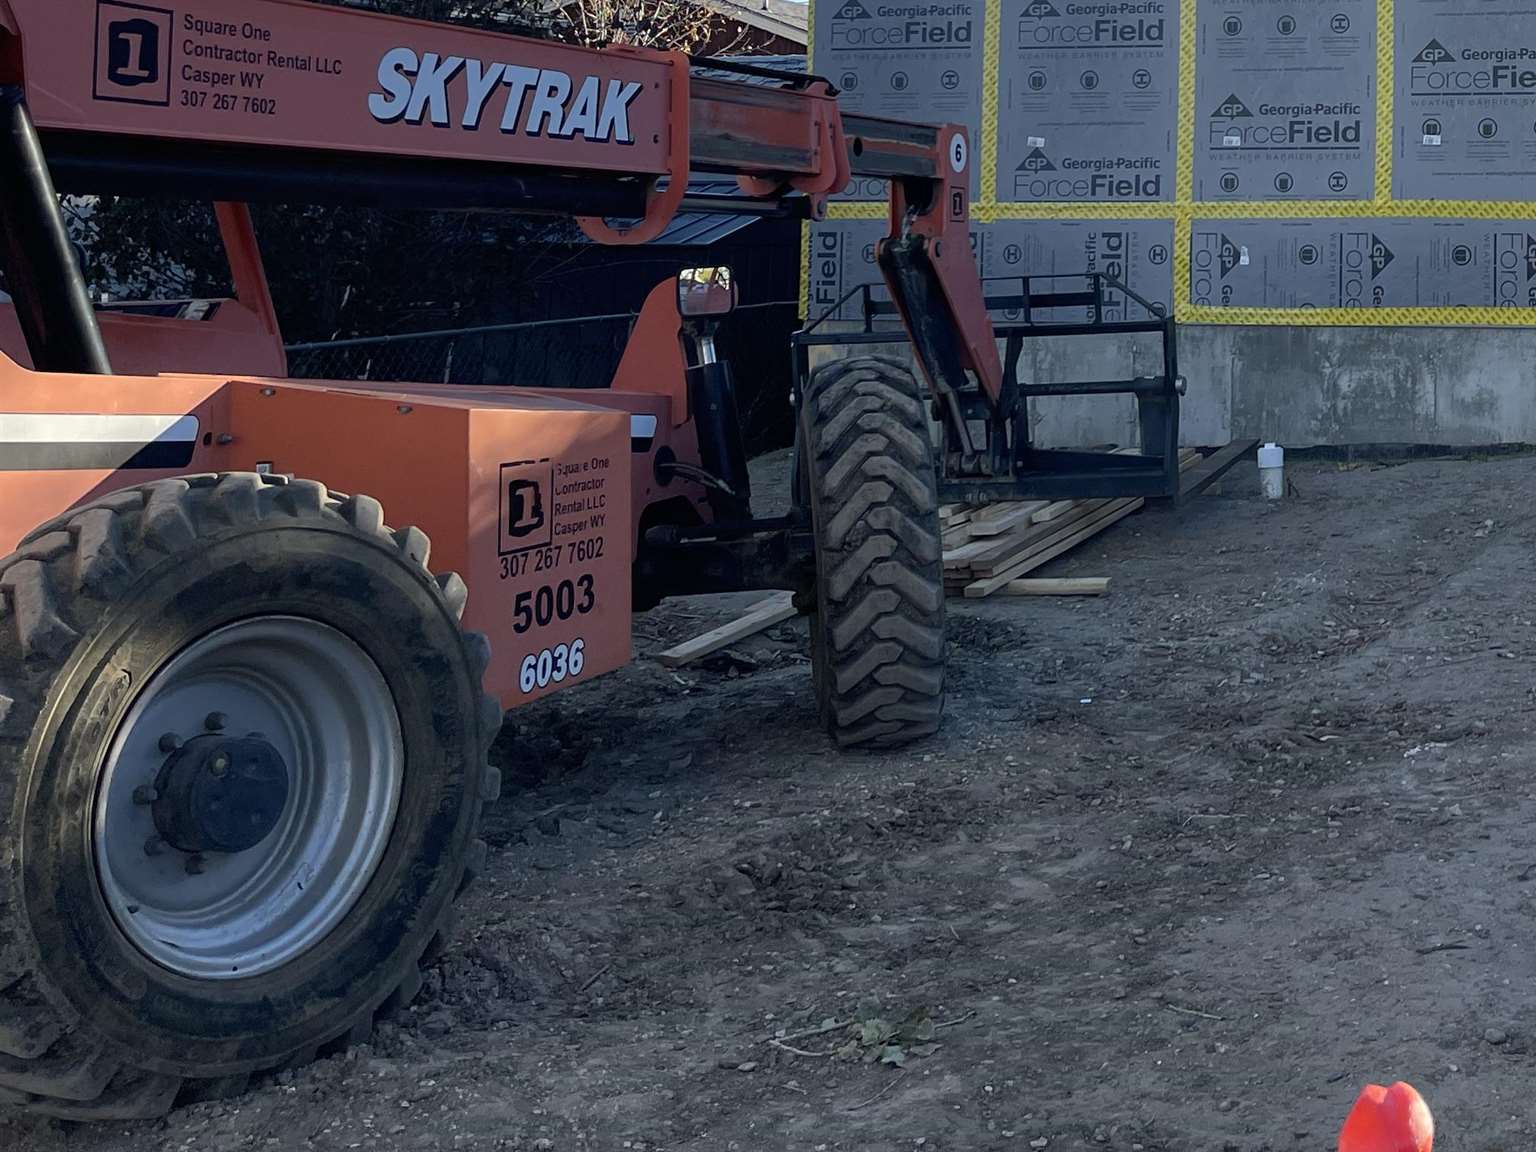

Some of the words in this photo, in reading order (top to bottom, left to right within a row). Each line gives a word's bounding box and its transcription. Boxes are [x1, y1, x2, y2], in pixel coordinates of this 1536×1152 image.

[877, 4, 972, 18] Georgia-Pacific
[1065, 2, 1164, 18] Georgia-Pacific
[184, 14, 237, 37] Square
[242, 22, 271, 41] One
[830, 21, 972, 45] ForceField
[1018, 19, 1164, 44] ForceField
[183, 39, 262, 65] Contractor
[267, 50, 311, 72] Rental
[316, 58, 343, 75] LLC
[182, 64, 236, 88] Casper
[240, 71, 264, 89] WY
[180, 90, 207, 107] 307
[213, 94, 238, 111] 267
[243, 97, 276, 115] 7602
[367, 47, 644, 145] SKYTRAK
[1258, 102, 1361, 119] Georgia-Pacific
[1209, 120, 1361, 145] ForceField
[955, 143, 962, 163] 6
[1061, 156, 1160, 173] Georgia-Pacific
[1014, 174, 1161, 198] ForceField
[591, 457, 610, 470] One
[554, 498, 585, 517] Rental
[587, 494, 606, 509] LLC
[554, 519, 588, 536] Casper
[590, 514, 607, 528] WY
[500, 553, 528, 580] 307
[534, 545, 562, 572] 267
[568, 536, 604, 564] 7602
[513, 573, 595, 634] 5003
[519, 637, 586, 694] 6036
